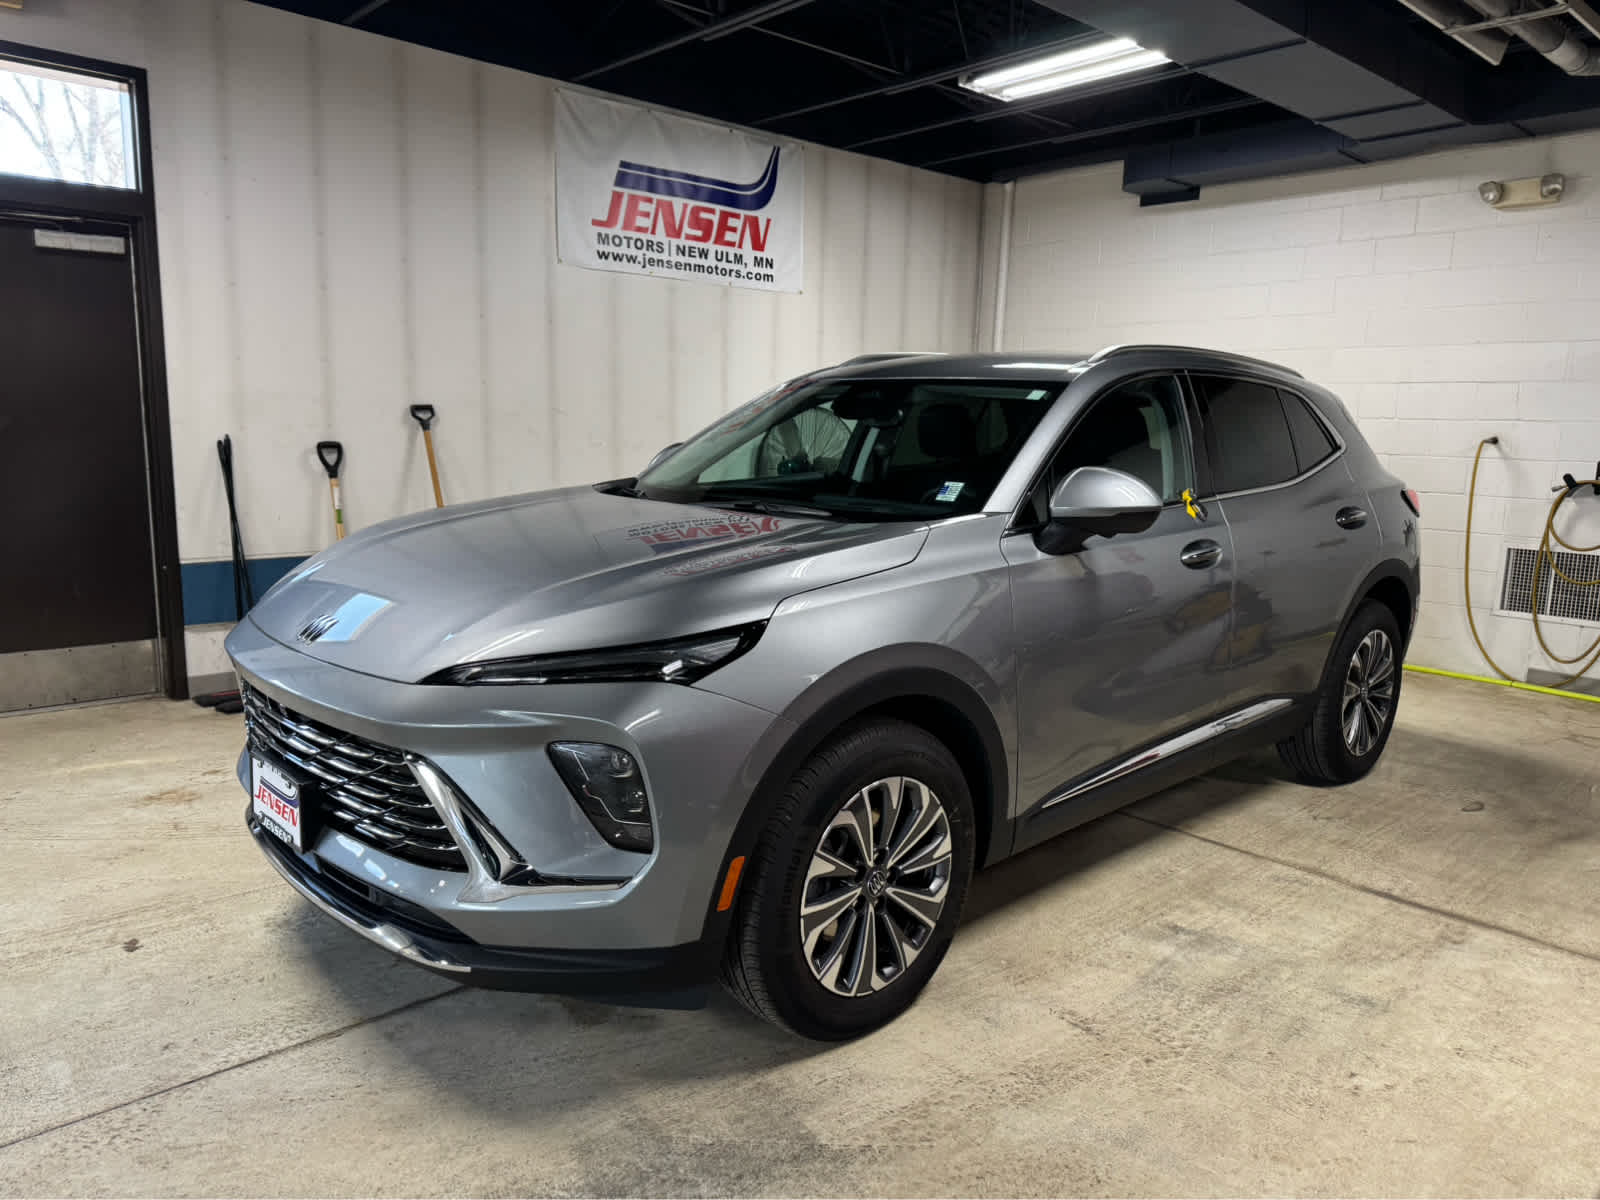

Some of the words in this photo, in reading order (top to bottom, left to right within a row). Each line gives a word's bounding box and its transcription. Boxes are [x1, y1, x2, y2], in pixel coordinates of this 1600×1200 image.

[591, 190, 772, 252] JENSEN
[597, 231, 664, 254] MOTORS
[676, 243, 709, 260] NEW
[715, 249, 748, 268] ULM,
[754, 255, 774, 269] MN
[597, 249, 774, 282] www.jensenmotors.com
[254, 785, 299, 827] JENSEN
